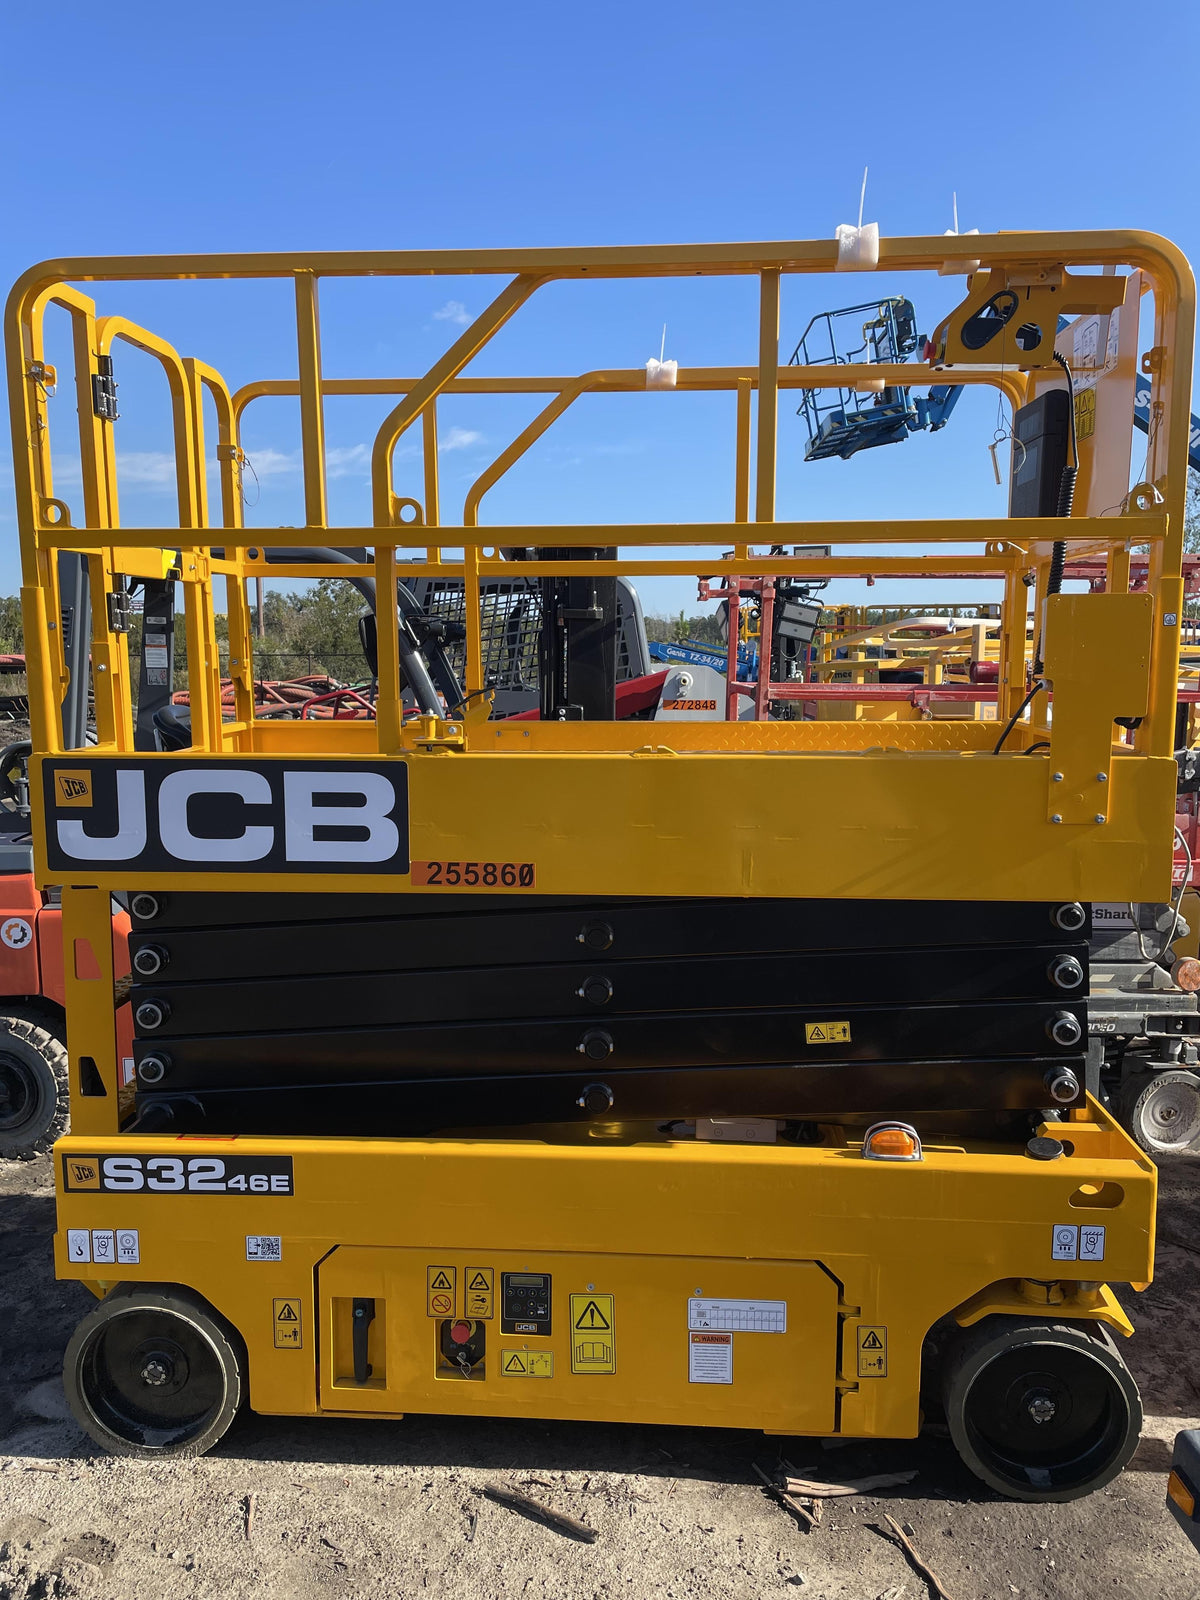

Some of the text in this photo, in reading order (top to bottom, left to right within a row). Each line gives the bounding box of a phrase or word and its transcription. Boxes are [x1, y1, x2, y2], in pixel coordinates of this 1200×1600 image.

[666, 648, 724, 667] Genie TZ-34/20
[672, 700, 716, 710] 272848
[64, 779, 86, 797] JCB
[57, 769, 399, 862] JCB
[427, 861, 534, 887] 255860
[75, 1164, 94, 1180] JCB
[702, 1335, 729, 1343] WARNING
